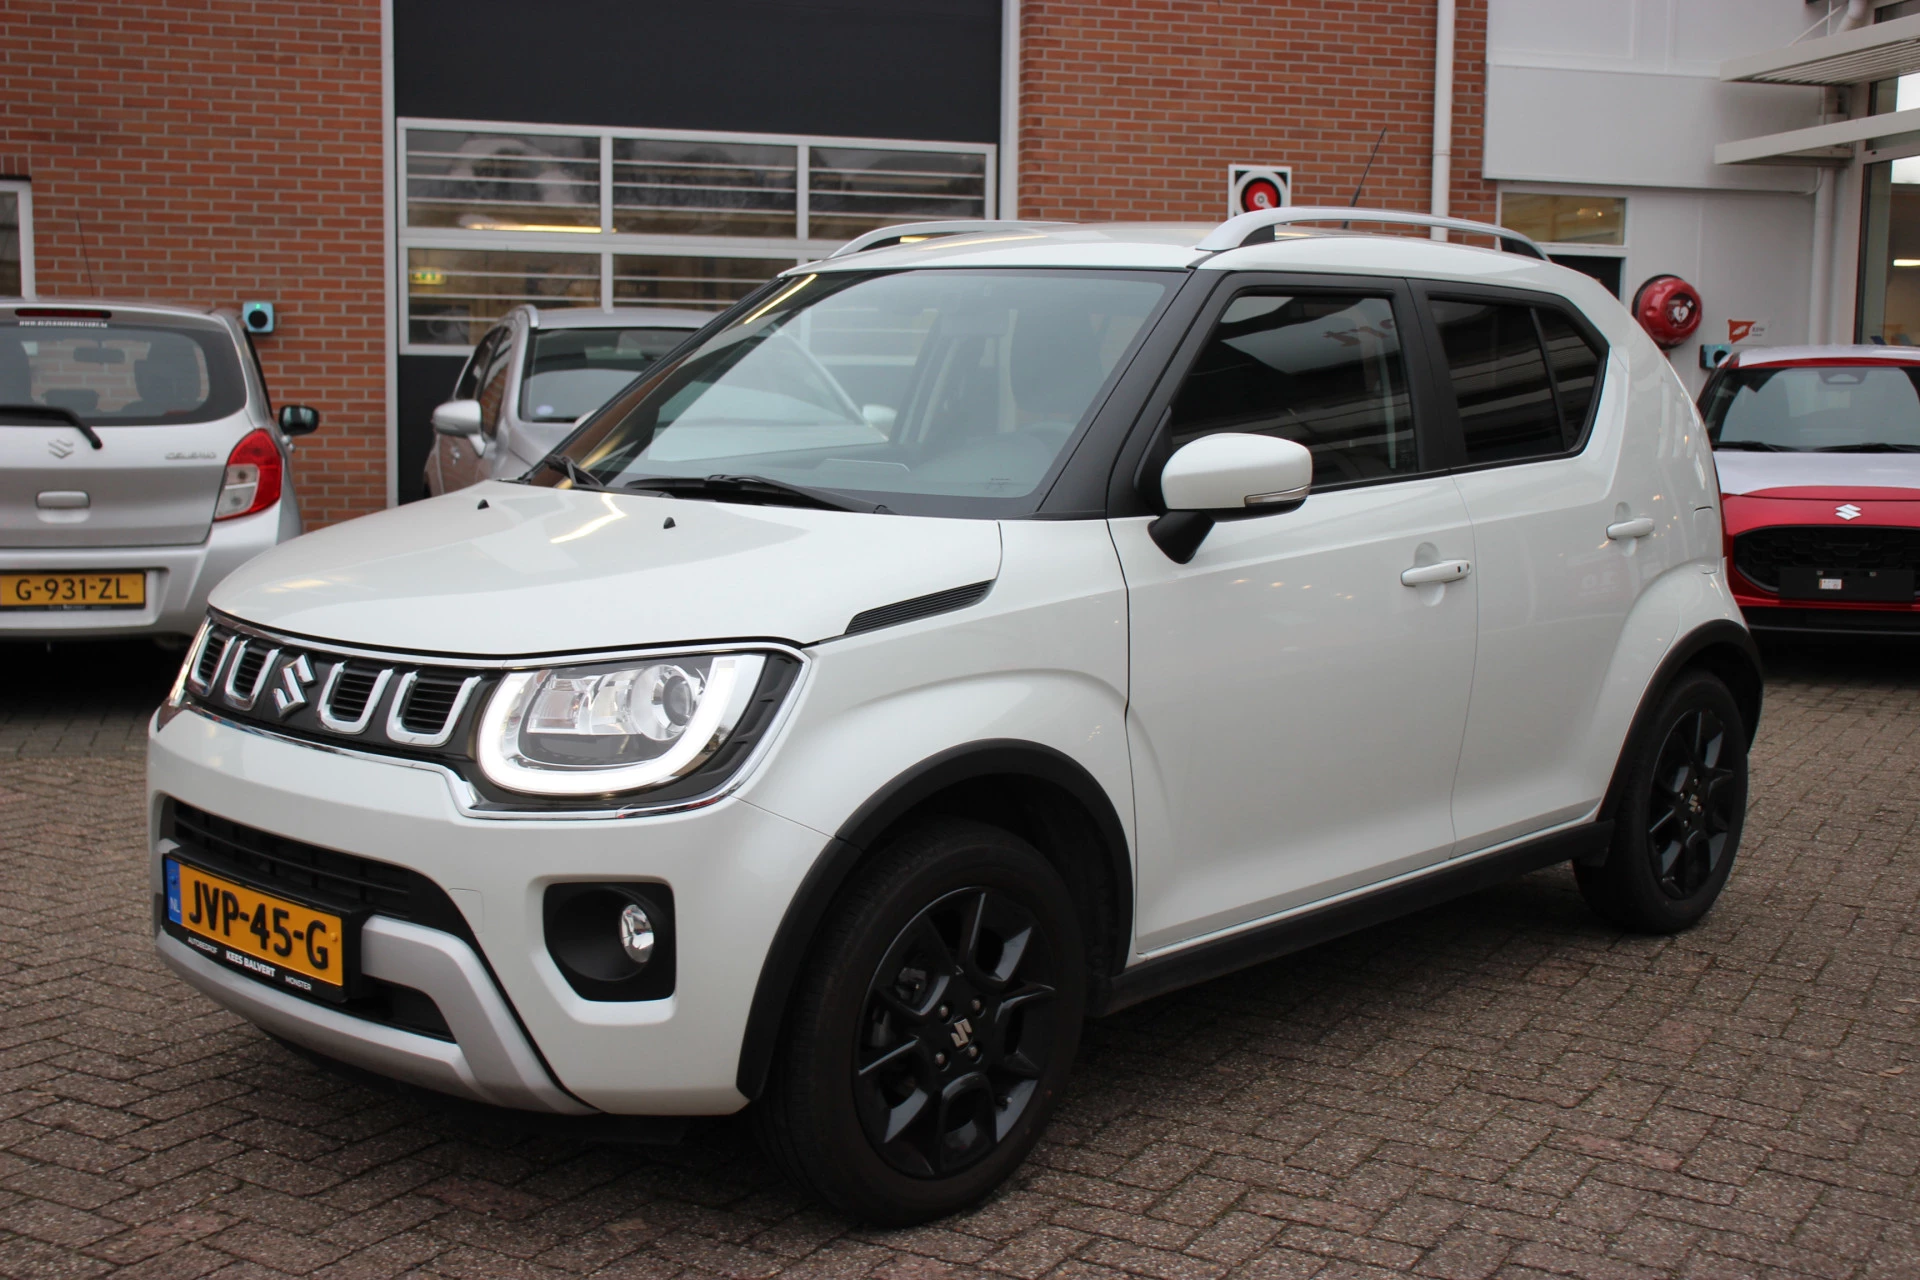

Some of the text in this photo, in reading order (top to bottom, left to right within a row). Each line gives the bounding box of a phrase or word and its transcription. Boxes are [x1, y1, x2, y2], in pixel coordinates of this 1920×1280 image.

[15, 578, 129, 601] G-931-ZL
[169, 896, 181, 914] NL
[189, 880, 329, 970] JVP-45-G
[225, 950, 276, 977] KEES BALVERT
[284, 975, 312, 991] MONSTER
